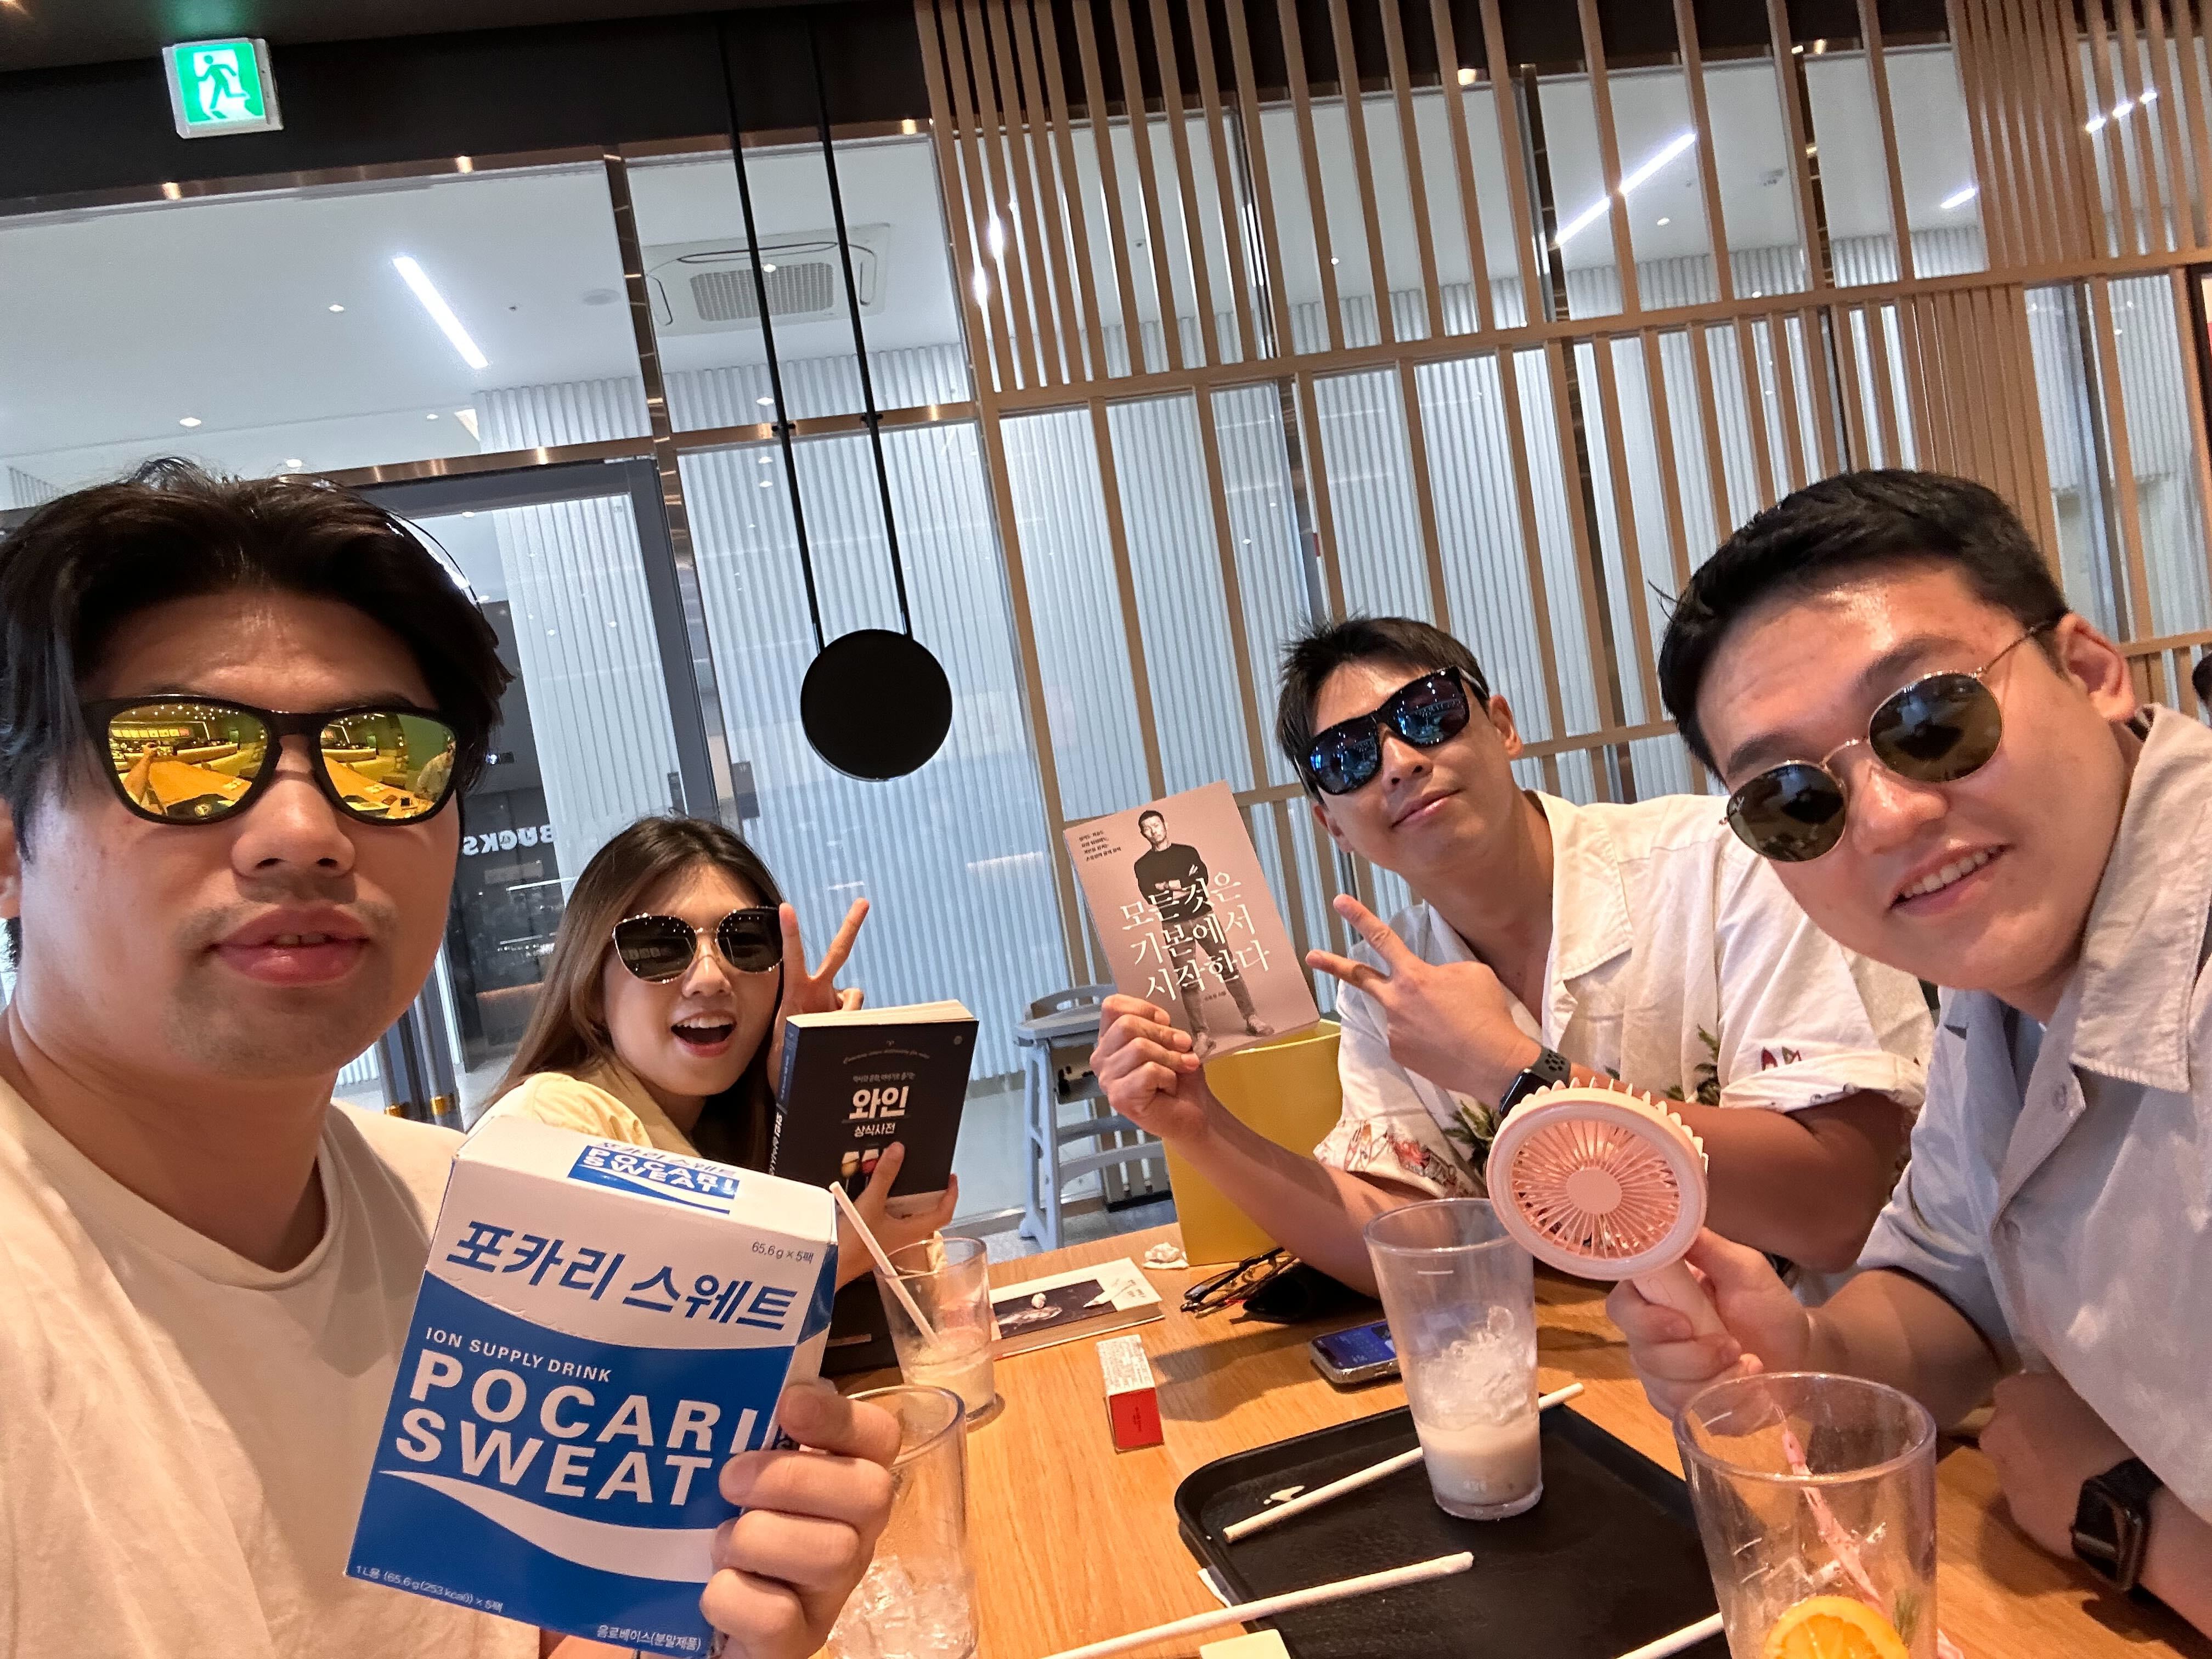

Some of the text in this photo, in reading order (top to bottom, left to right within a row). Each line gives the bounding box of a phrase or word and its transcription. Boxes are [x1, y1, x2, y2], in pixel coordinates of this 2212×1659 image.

[1120, 872, 1242, 930] 모든 것은
[1131, 904, 1255, 966] 기본에서
[1146, 940, 1270, 1000] 시작한다
[849, 1086, 909, 1119] 와인
[854, 1122, 895, 1137] 상식사전
[583, 1155, 718, 1192] SWEAT
[588, 1148, 735, 1192] POCARI
[446, 1221, 798, 1331] 포카리 스웨트
[426, 1327, 612, 1383] ION SUPPLY DRINK
[409, 1348, 759, 1454] POCARI
[396, 1408, 712, 1506] SWEAT
